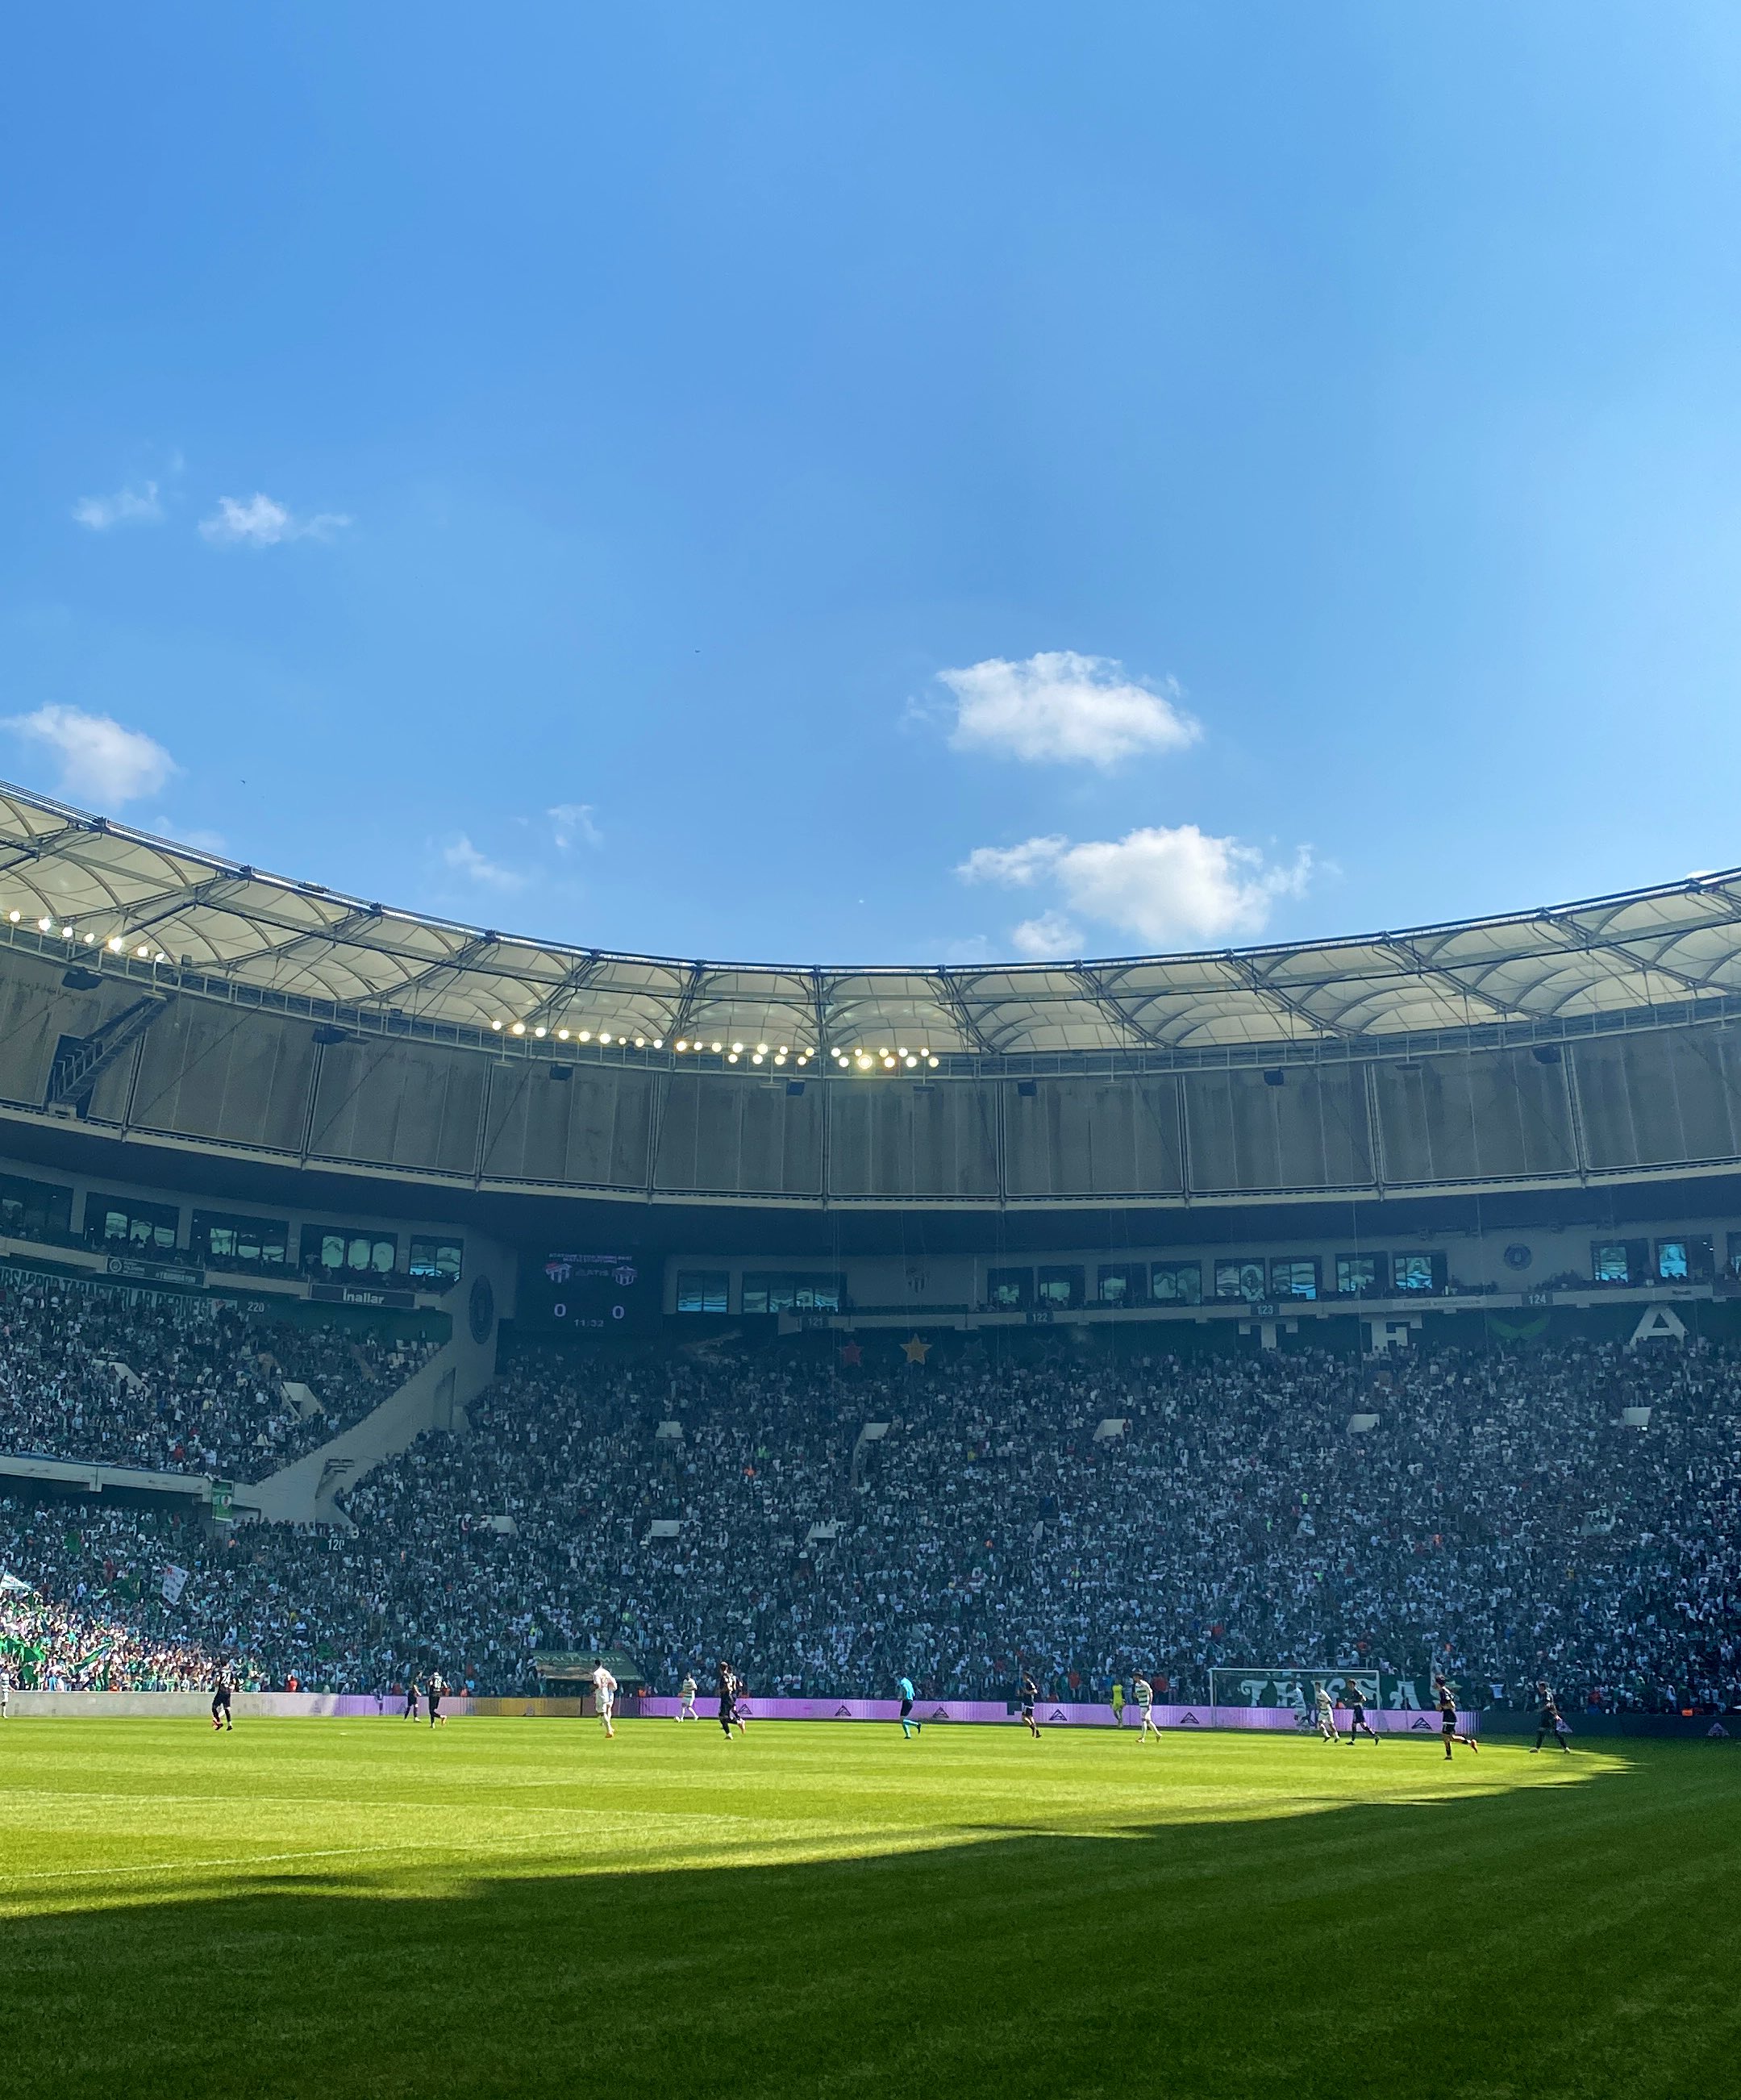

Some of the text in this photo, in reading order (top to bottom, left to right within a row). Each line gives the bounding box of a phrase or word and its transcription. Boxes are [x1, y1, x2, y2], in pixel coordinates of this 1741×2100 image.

[1528, 1294, 1547, 1304] 124
[247, 1302, 264, 1312] 220
[554, 1303, 625, 1319] 0 0
[1257, 1305, 1273, 1315] 123
[1032, 1312, 1048, 1323] 122
[1629, 1304, 1685, 1349] A
